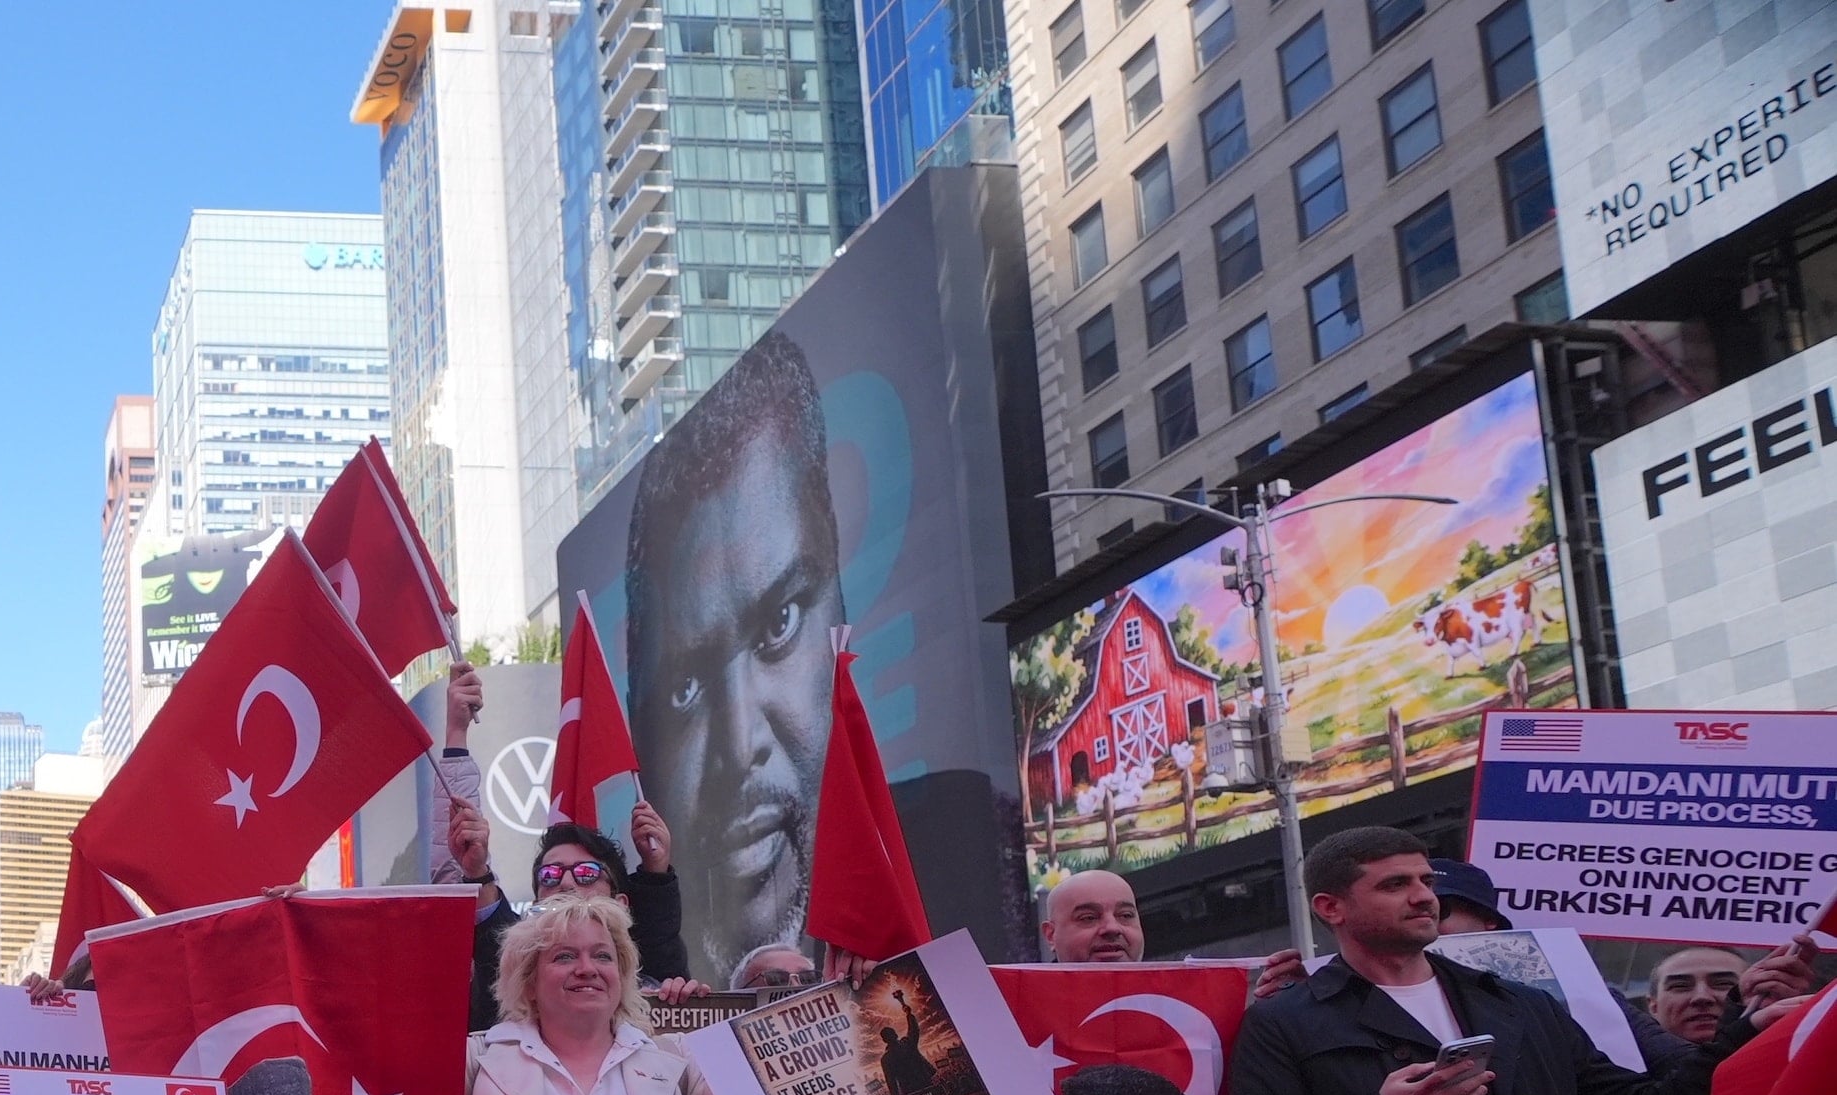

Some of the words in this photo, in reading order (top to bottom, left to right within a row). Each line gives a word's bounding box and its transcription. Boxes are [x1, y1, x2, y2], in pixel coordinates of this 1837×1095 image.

[1605, 133, 1789, 256] REQUIRED
[1674, 722, 1749, 741] TASC
[1526, 768, 1733, 798] MAMDANI
[1737, 773, 1837, 800] MUT
[1589, 799, 1655, 821] DUE
[1657, 801, 1819, 828] PROCESS,
[1494, 841, 1636, 866] DECREES
[1640, 847, 1813, 872] GENOCIDE
[1579, 869, 1632, 889] ON
[1633, 871, 1810, 897] INNOCENT
[1493, 887, 1652, 917] TURKISH
[742, 1015, 781, 1045] THE
[778, 993, 840, 1031] TRUTH
[754, 1037, 789, 1061] DOES
[788, 1026, 815, 1048] NOT
[816, 1014, 851, 1038] NEED
[764, 1061, 780, 1082] A
[779, 1036, 854, 1076] CROWD;
